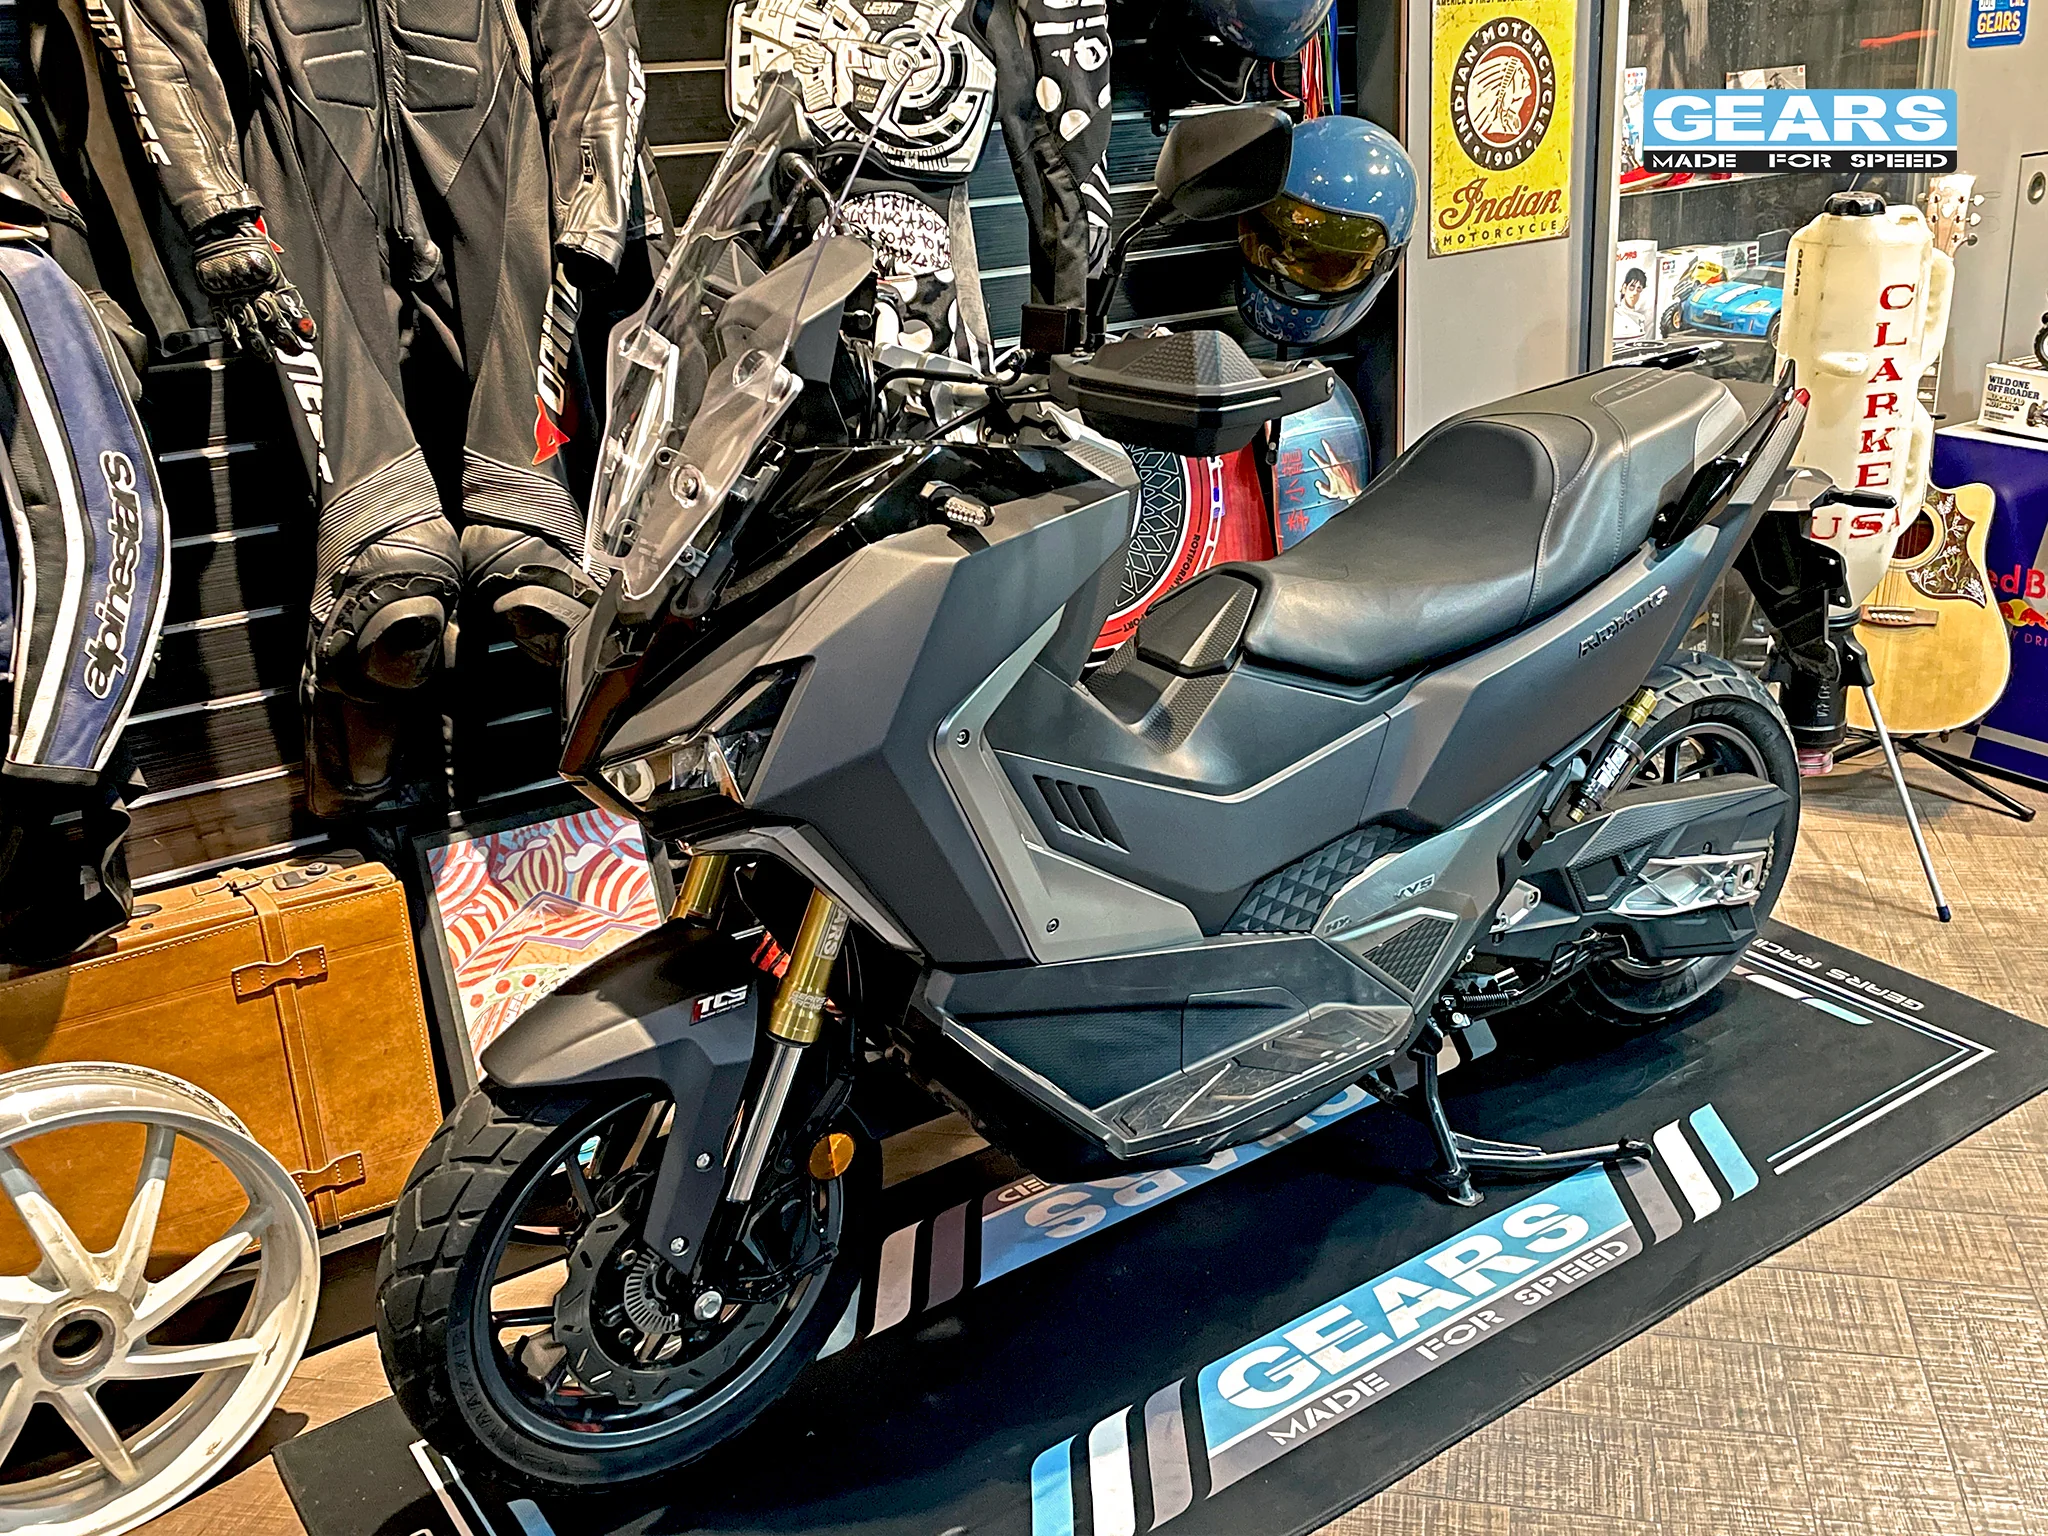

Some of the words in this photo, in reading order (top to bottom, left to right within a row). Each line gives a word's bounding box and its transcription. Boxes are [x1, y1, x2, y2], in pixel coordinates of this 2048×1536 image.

[1977, 10, 2021, 34] GEARS
[1454, 45, 1479, 144] INDIAN
[1480, 21, 1554, 137] MOTORCYCLE
[1485, 148, 1523, 167] 1901
[1438, 176, 1562, 231] Indian
[1443, 219, 1557, 247] MOTORCYCLE
[1855, 283, 1916, 488] CLARKE
[1987, 383, 2003, 393] OFF
[2003, 386, 2040, 400] ROADER
[1989, 375, 2012, 387] WILD
[2012, 379, 2030, 390] ONE
[84, 451, 142, 699] alpinestars
[1986, 564, 2022, 595] ed
[697, 985, 748, 1014] TCS
[1825, 967, 1926, 1012] GEARS
[1216, 1203, 1590, 1409] GEARS
[1266, 1371, 1391, 1446] MADE
[1415, 1309, 1506, 1362] FOR
[1513, 1240, 1629, 1307] SPEED
